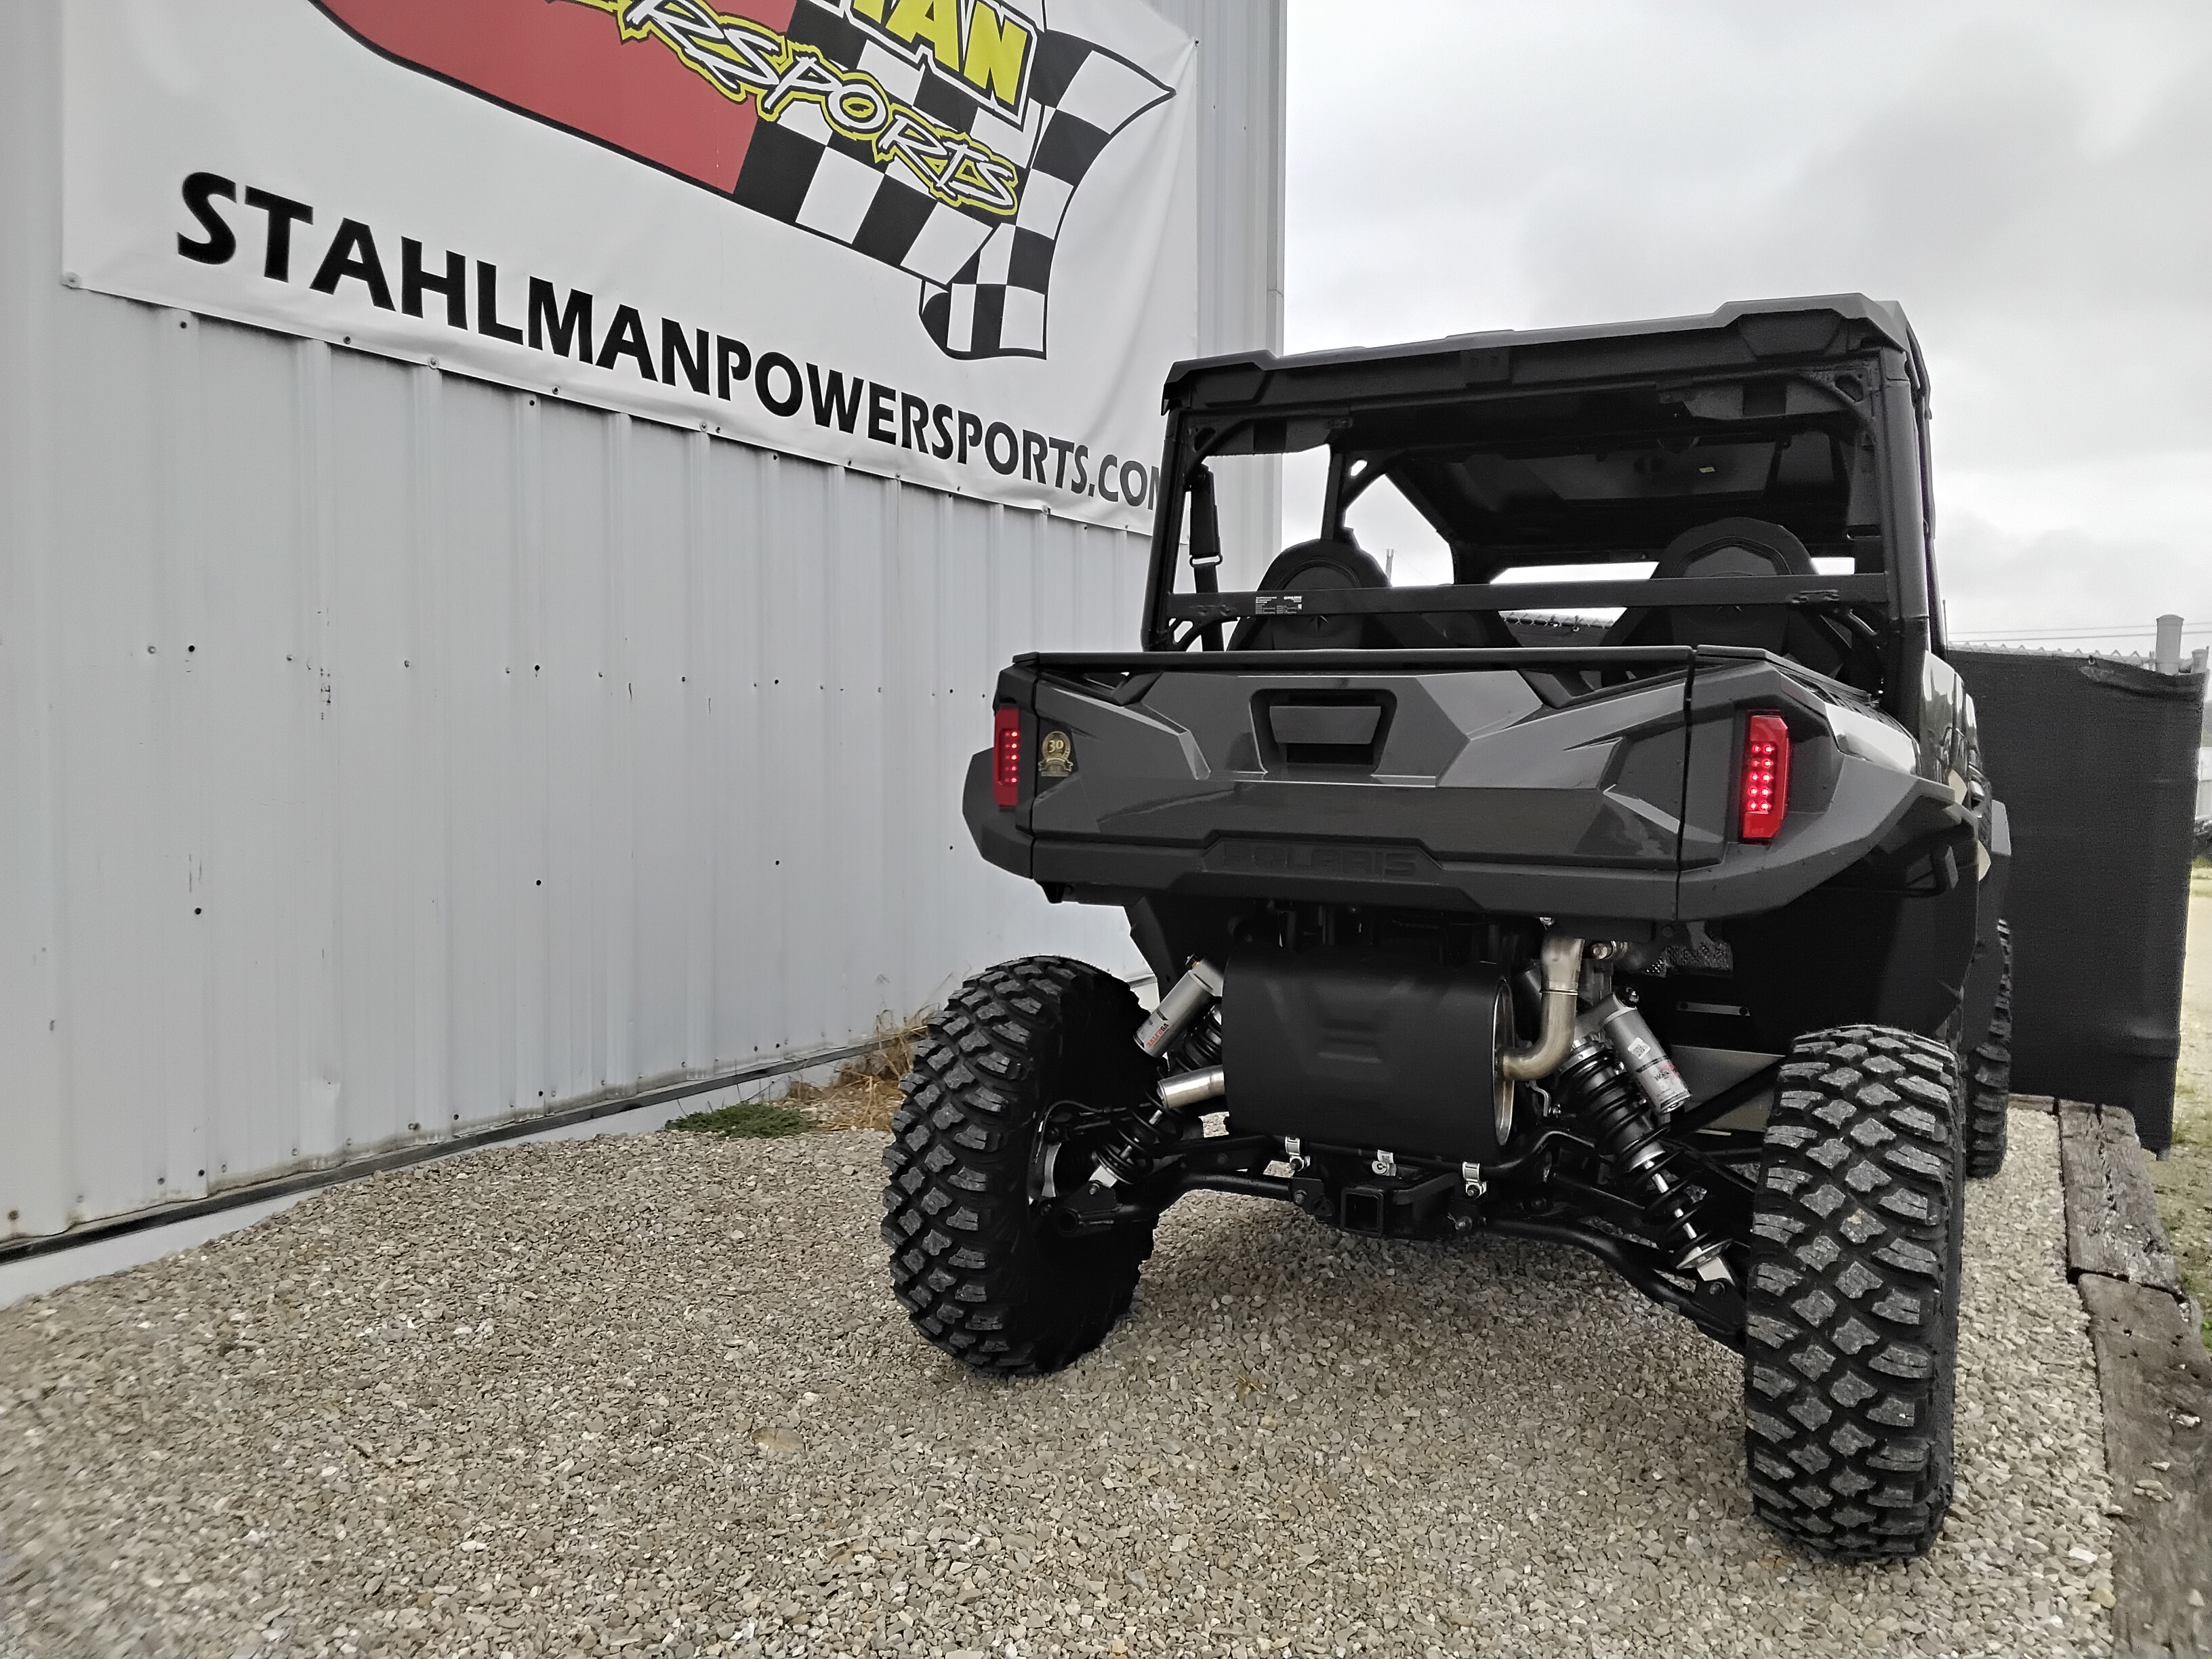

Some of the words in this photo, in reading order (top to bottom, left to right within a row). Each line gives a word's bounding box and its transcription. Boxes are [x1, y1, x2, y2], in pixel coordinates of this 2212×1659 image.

[852, 0, 1027, 106] AN
[1048, 740, 1064, 753] 30
[1224, 844, 1417, 877] POLARIS
